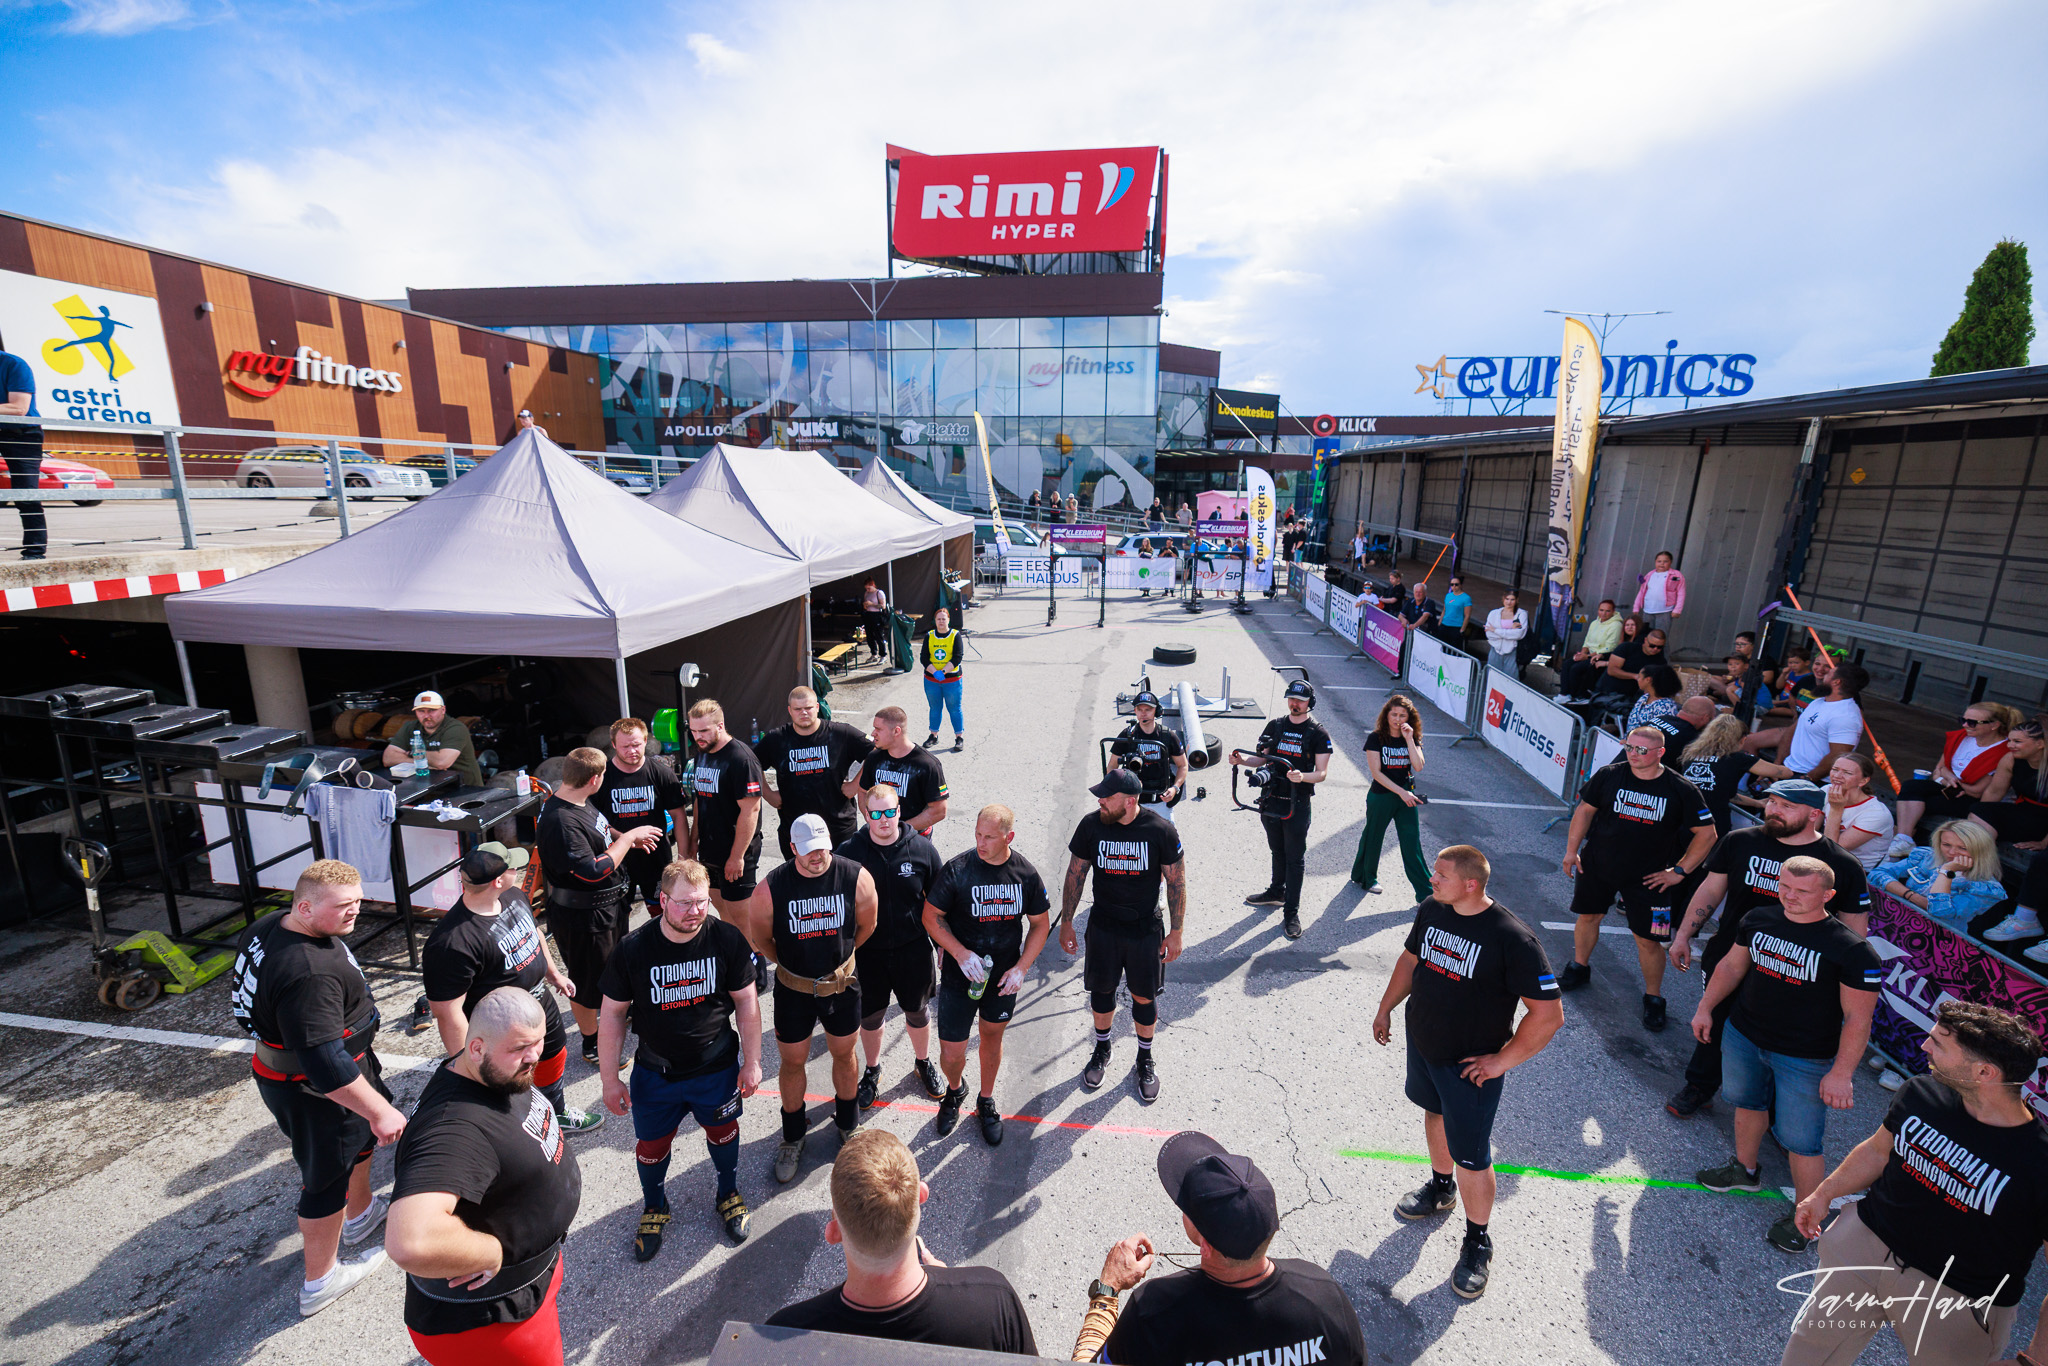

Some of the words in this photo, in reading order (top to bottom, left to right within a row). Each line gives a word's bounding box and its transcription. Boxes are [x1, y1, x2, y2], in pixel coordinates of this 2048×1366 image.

[991, 223, 1076, 240] HYPER
[52, 388, 122, 407] astri
[67, 405, 152, 425] arena
[1338, 417, 1377, 433] KLICK
[664, 425, 723, 437] APOLLO
[927, 422, 970, 436] Betta
[1337, 595, 1353, 616] EESTI
[1488, 699, 1501, 719] 24
[789, 745, 830, 763] STRONGMAN
[789, 757, 830, 772] STRONGWOMAN
[611, 785, 655, 803] STRONGMAN
[1614, 788, 1667, 812] STRONGMAN
[1613, 800, 1665, 821] STRONGWOMAN
[1098, 840, 1149, 860] STRONGMAN
[1097, 855, 1149, 871] STRONGWOMAN
[972, 884, 1023, 905] STRONGMAN
[789, 894, 846, 922] STRONGMAN
[971, 899, 1023, 917] STRONGWOMAN
[789, 910, 845, 934] STRONGWOMAN
[797, 931, 823, 940] ESTONIA
[1423, 926, 1482, 963] STRONGMAN
[1750, 931, 1822, 969] STRONGMAN
[1774, 953, 1787, 962] PRO
[1420, 942, 1478, 979] STRONGWOMAN
[1749, 946, 1817, 983] STRONGWOMAN
[650, 956, 717, 989] STRONGMAN
[1425, 960, 1446, 975] ESTONIA
[1447, 971, 1461, 982] 2026
[1756, 964, 1783, 980] ESTONIA
[1784, 975, 1802, 986] 2026
[650, 975, 717, 1005] STRONGWOMAN
[661, 1000, 691, 1011] ESTONIA
[1898, 1115, 2011, 1198] STRONGMAN
[1931, 1157, 1950, 1172] PRO
[1894, 1133, 2000, 1216] STRONGWOMAN
[1901, 1161, 1939, 1195] ESTONIA
[1943, 1194, 1968, 1213] 2026
